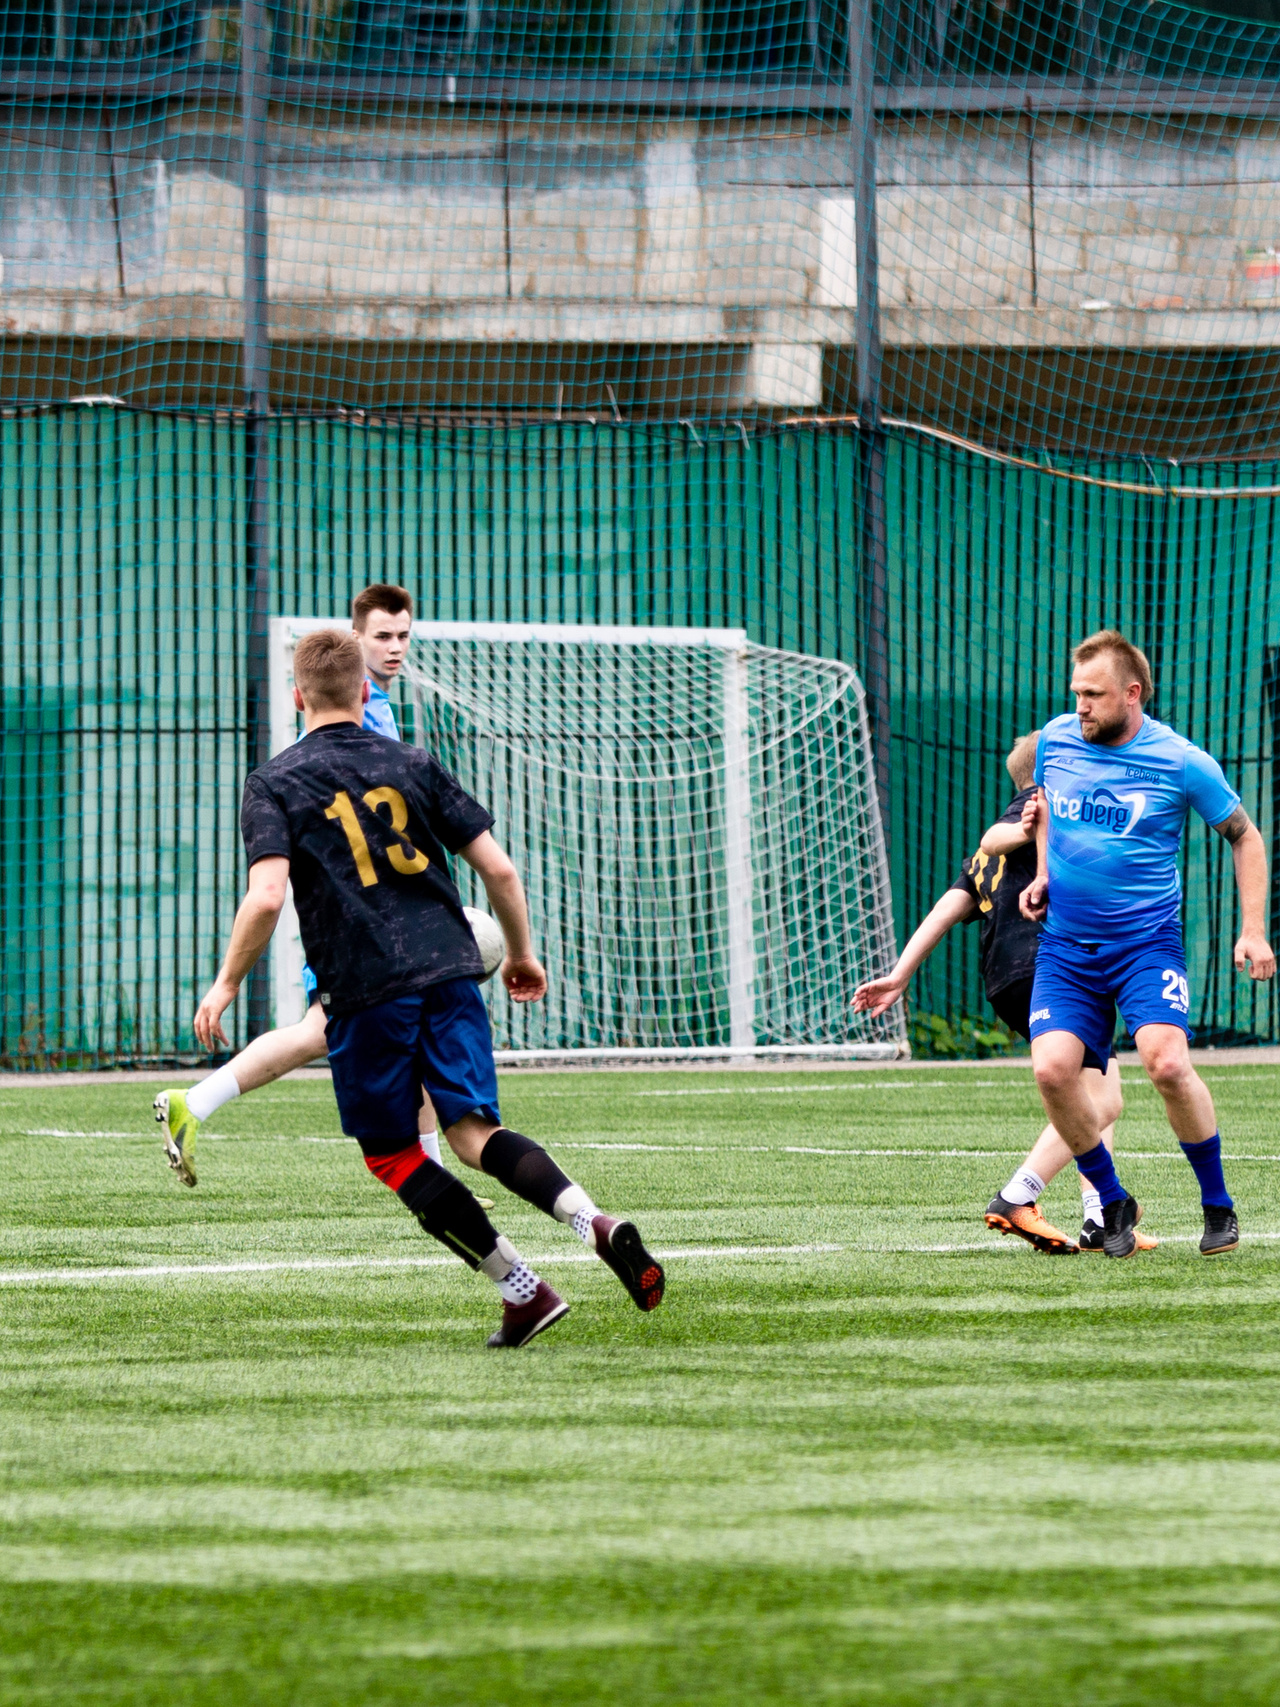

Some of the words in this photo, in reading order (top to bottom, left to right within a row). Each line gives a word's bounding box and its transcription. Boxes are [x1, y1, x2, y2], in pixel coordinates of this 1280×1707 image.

[1125, 766, 1160, 785] Iceberg
[324, 786, 429, 887] 13
[1162, 969, 1188, 1007] 29
